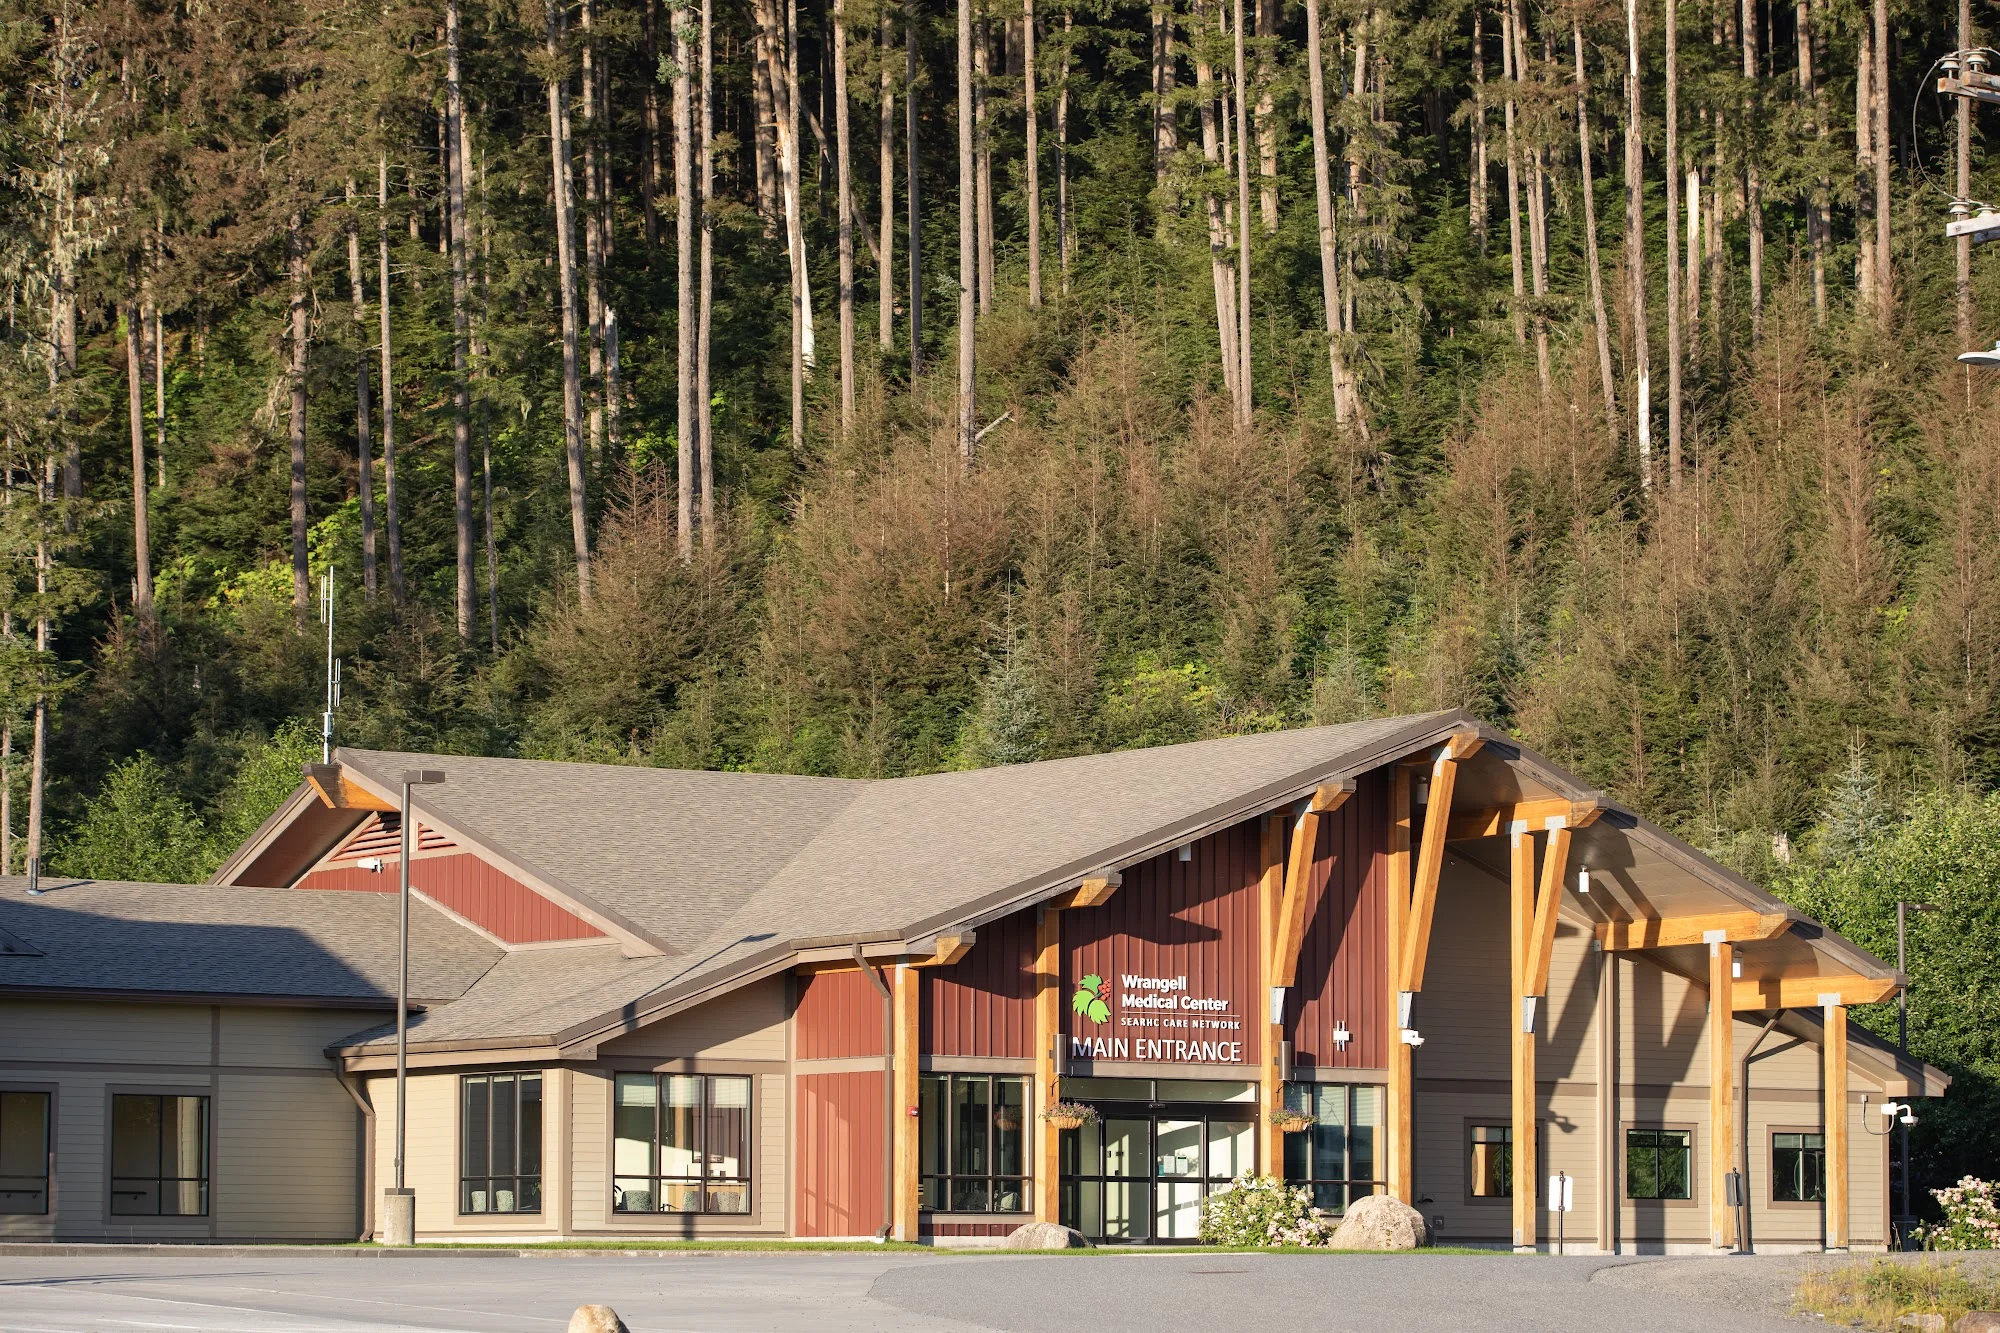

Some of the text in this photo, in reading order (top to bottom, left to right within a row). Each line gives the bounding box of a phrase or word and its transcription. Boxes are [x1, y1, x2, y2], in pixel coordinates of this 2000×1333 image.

[1121, 974, 1187, 993] Wrangell
[1121, 993, 1229, 1011] Medical Center
[1120, 1017, 1240, 1030] SEARHC CARE NETWORK
[1072, 1036, 1242, 1062] MAIN ENTRANCE
